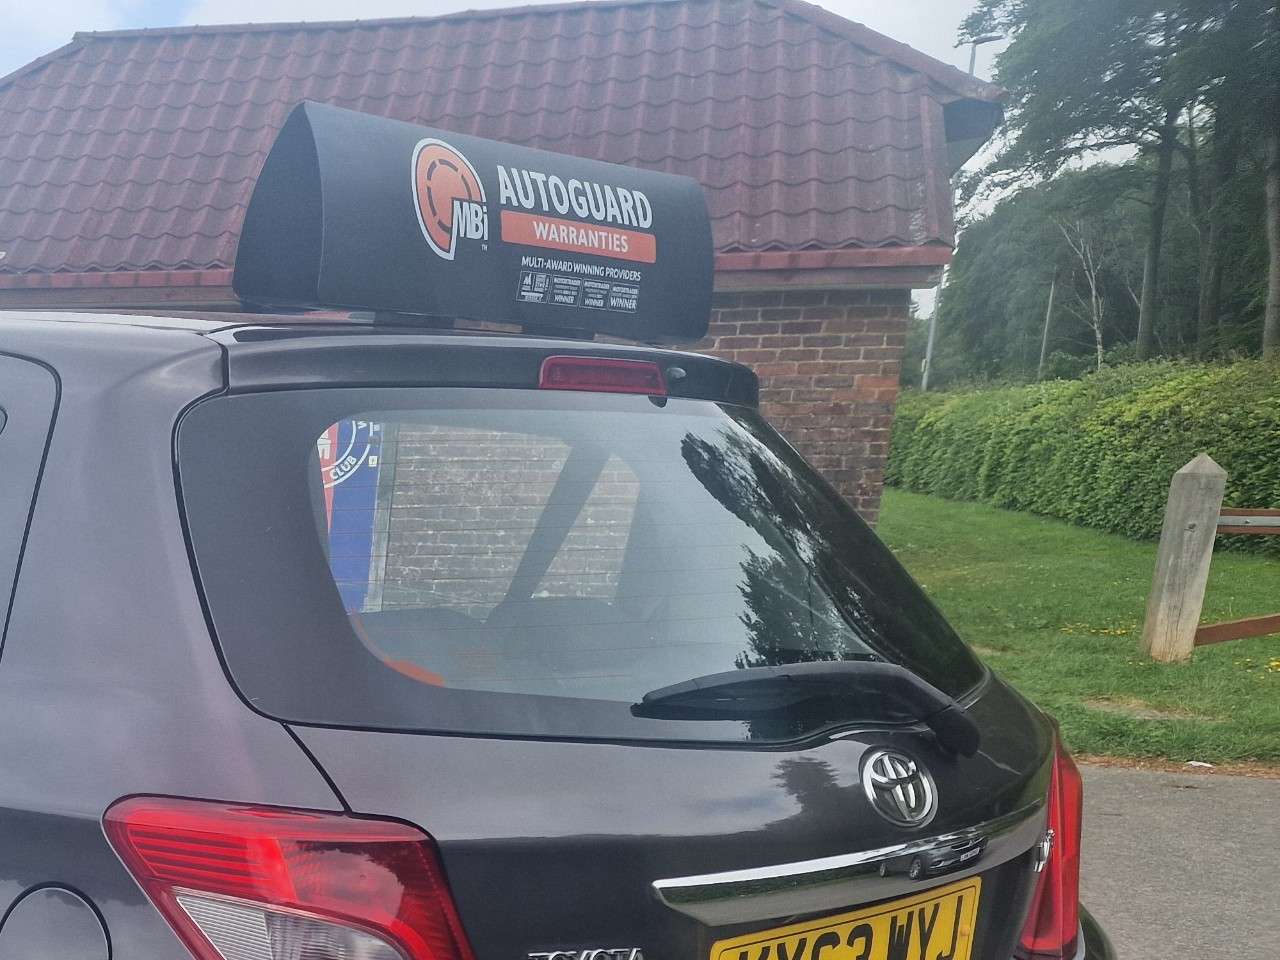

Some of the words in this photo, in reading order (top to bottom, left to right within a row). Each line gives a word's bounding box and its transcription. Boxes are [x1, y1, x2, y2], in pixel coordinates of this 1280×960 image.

[496, 165, 653, 229] AUTOGUARD
[452, 200, 489, 240] MBi
[532, 220, 629, 253] WARRANTIES
[521, 256, 573, 272] MULTI-AWARD
[573, 263, 605, 277] WINNING
[605, 267, 642, 282] PROVIDERS
[610, 297, 637, 310] WINNER
[329, 455, 357, 480] CLUB
